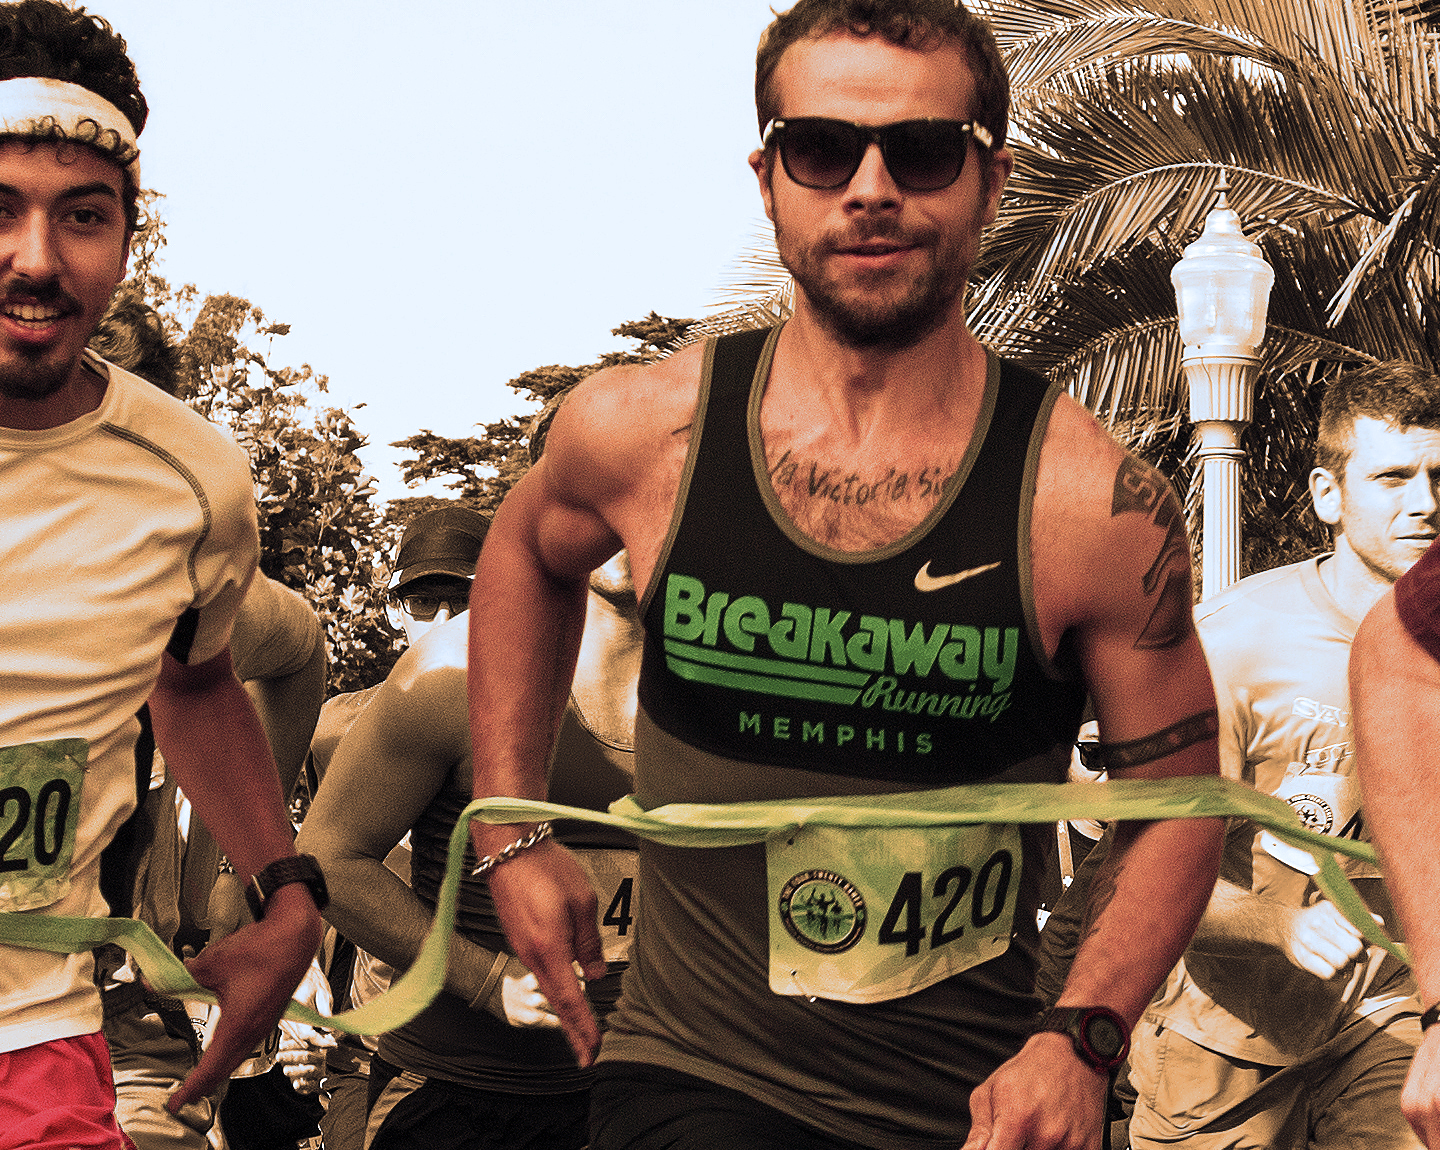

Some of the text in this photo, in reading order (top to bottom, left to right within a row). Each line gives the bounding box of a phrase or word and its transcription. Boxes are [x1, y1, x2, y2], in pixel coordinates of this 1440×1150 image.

[663, 572, 1019, 692] Breakaway
[738, 711, 933, 754] MEMPHIS
[862, 674, 1012, 723] Running
[878, 849, 1013, 957] 420
